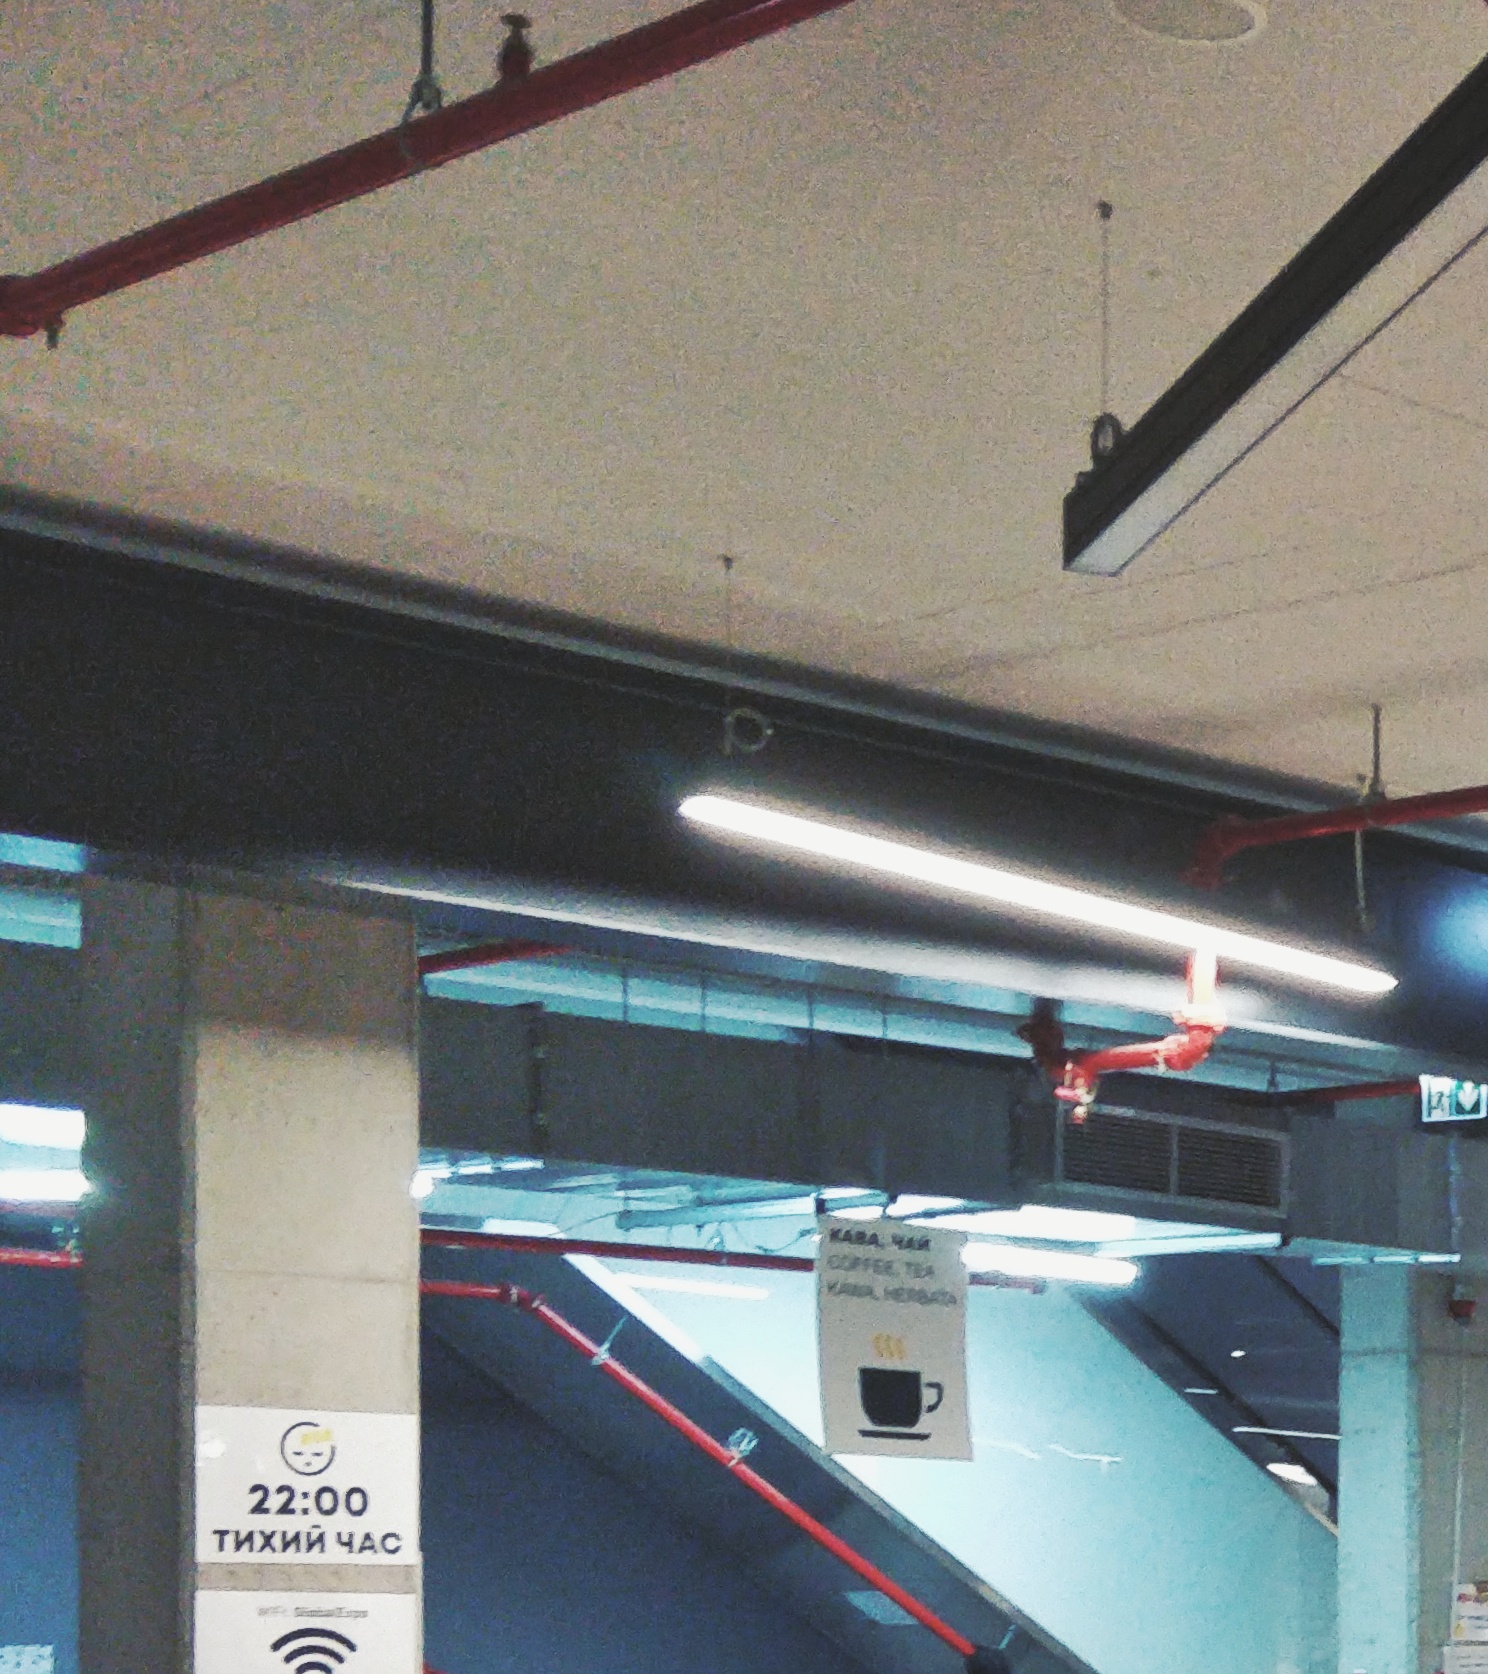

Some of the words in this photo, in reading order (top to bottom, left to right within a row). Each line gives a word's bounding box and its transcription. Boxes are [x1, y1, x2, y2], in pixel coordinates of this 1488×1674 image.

[248, 1483, 368, 1517] 22:00
[212, 1524, 326, 1554] ТИХИЙ
[336, 1532, 402, 1555] ЧАС
